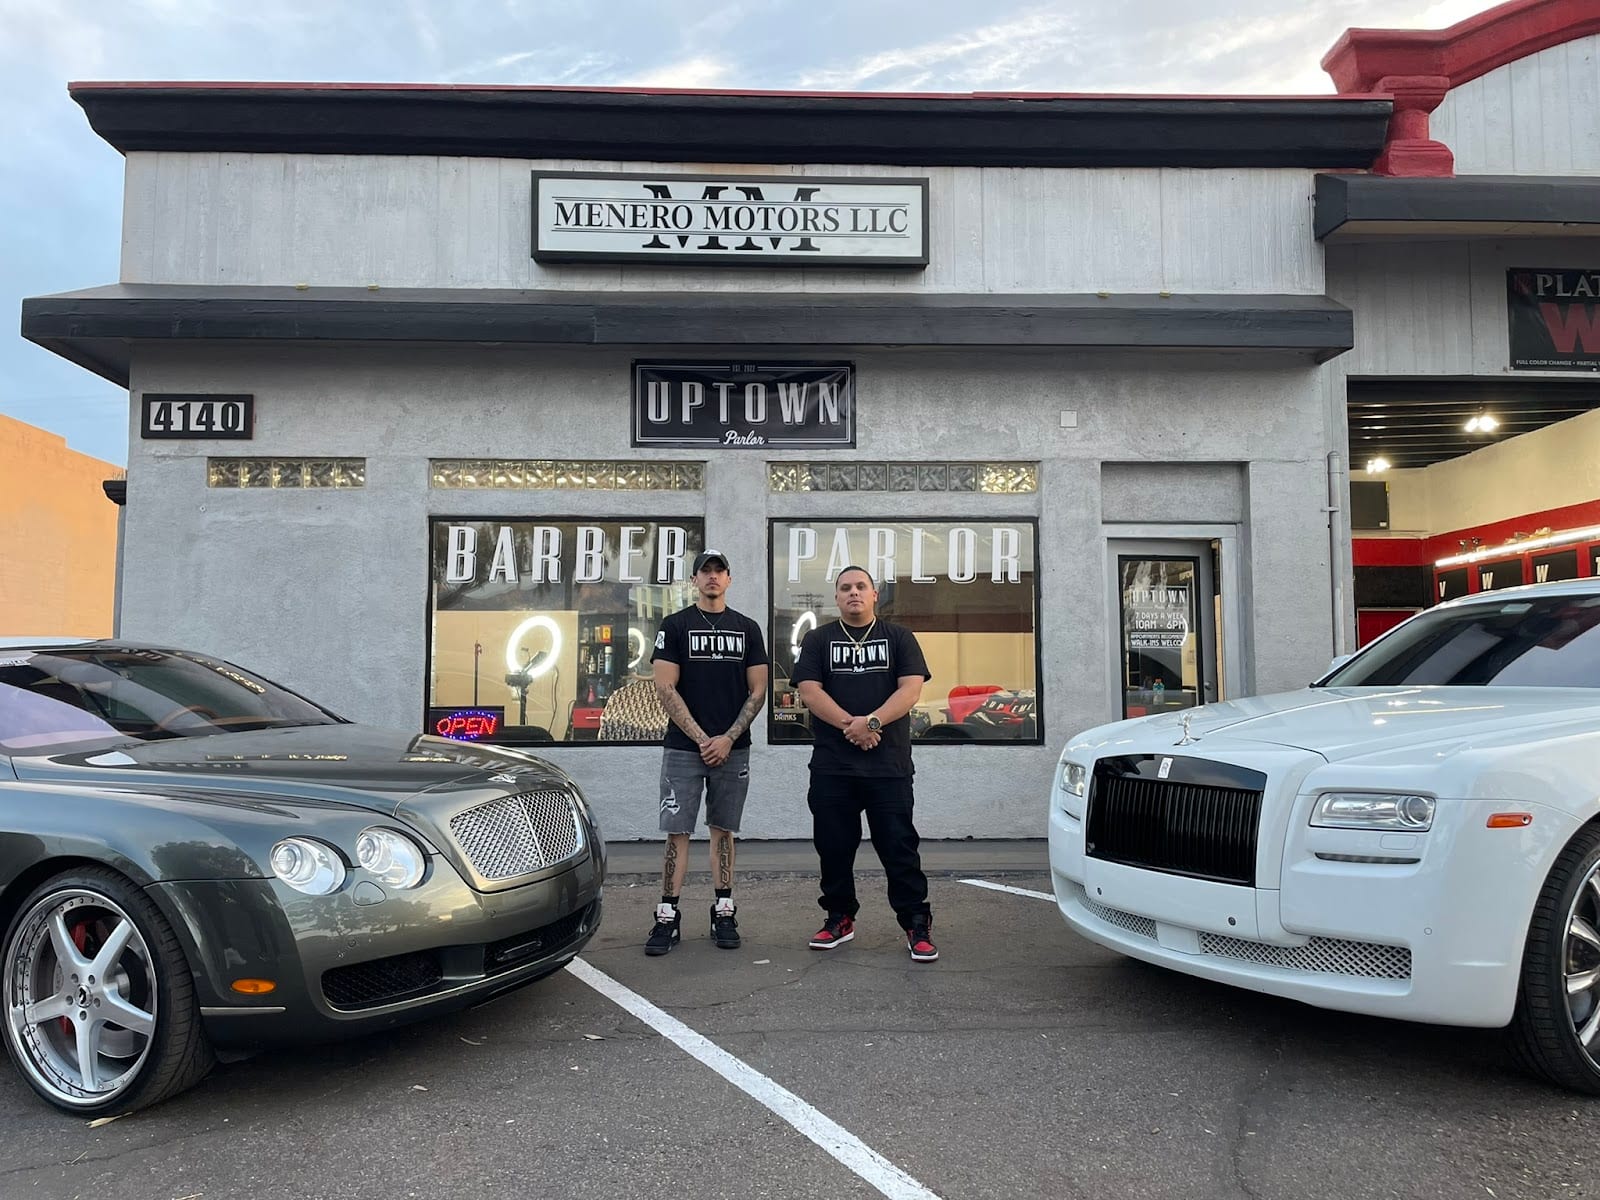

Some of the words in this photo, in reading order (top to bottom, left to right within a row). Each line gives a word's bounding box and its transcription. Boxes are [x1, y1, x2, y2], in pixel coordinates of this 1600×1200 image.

[554, 202, 693, 230] MENERO
[703, 205, 840, 232] MOTORS
[849, 207, 909, 234] LLC
[647, 381, 841, 425] UPTOWN
[153, 402, 240, 432] 4140
[723, 430, 765, 446] Parlor
[446, 525, 689, 584] BARBER
[787, 527, 1022, 584] PARLOR
[1482, 571, 1494, 590] W
[1535, 564, 1549, 583] W
[1133, 590, 1186, 603] UPTOWN
[1135, 620, 1157, 630] 10AM
[1166, 620, 1185, 630] 6PM
[1141, 612, 1158, 620] DAYS
[1160, 612, 1165, 620] A
[691, 635, 743, 653] UPTOWN
[833, 644, 886, 665] UPTOWN
[436, 717, 497, 735] OPEN
[774, 712, 797, 721] DRINKS
